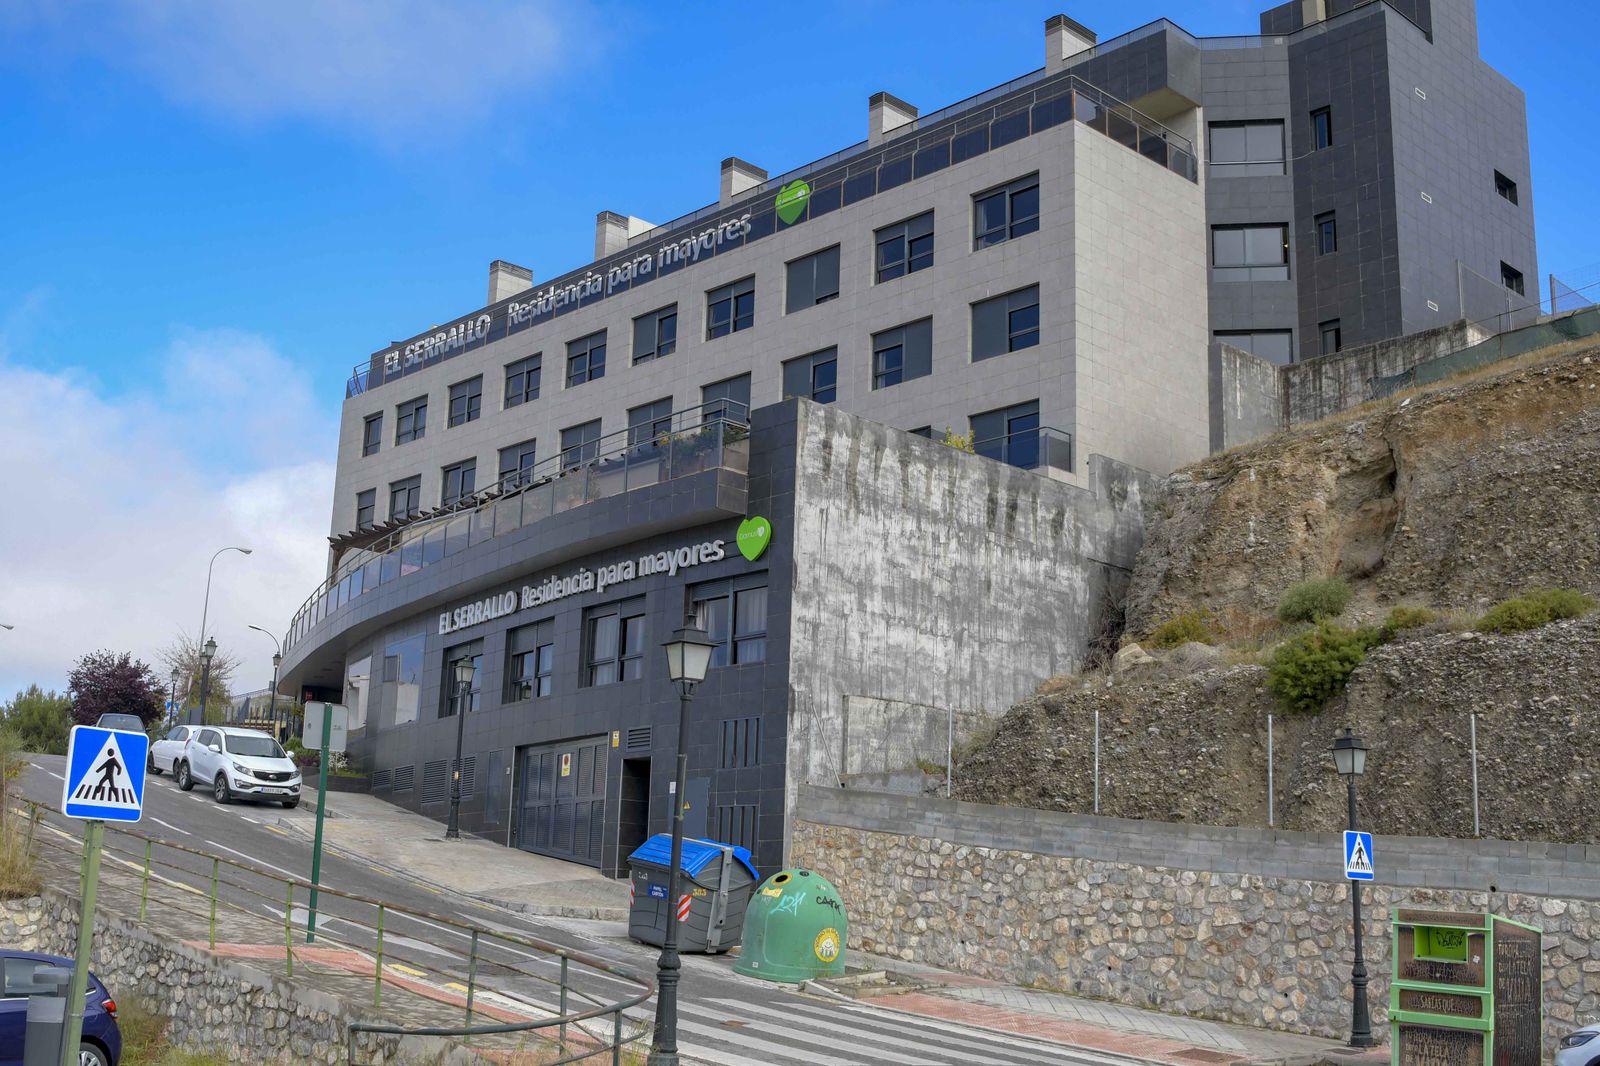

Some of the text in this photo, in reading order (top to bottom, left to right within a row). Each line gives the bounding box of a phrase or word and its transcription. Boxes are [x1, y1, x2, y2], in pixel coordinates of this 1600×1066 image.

[384, 213, 752, 375] EL SERRALLO Residencia para mayores
[438, 539, 726, 635] EL SERRALLO Residencia para mayores
